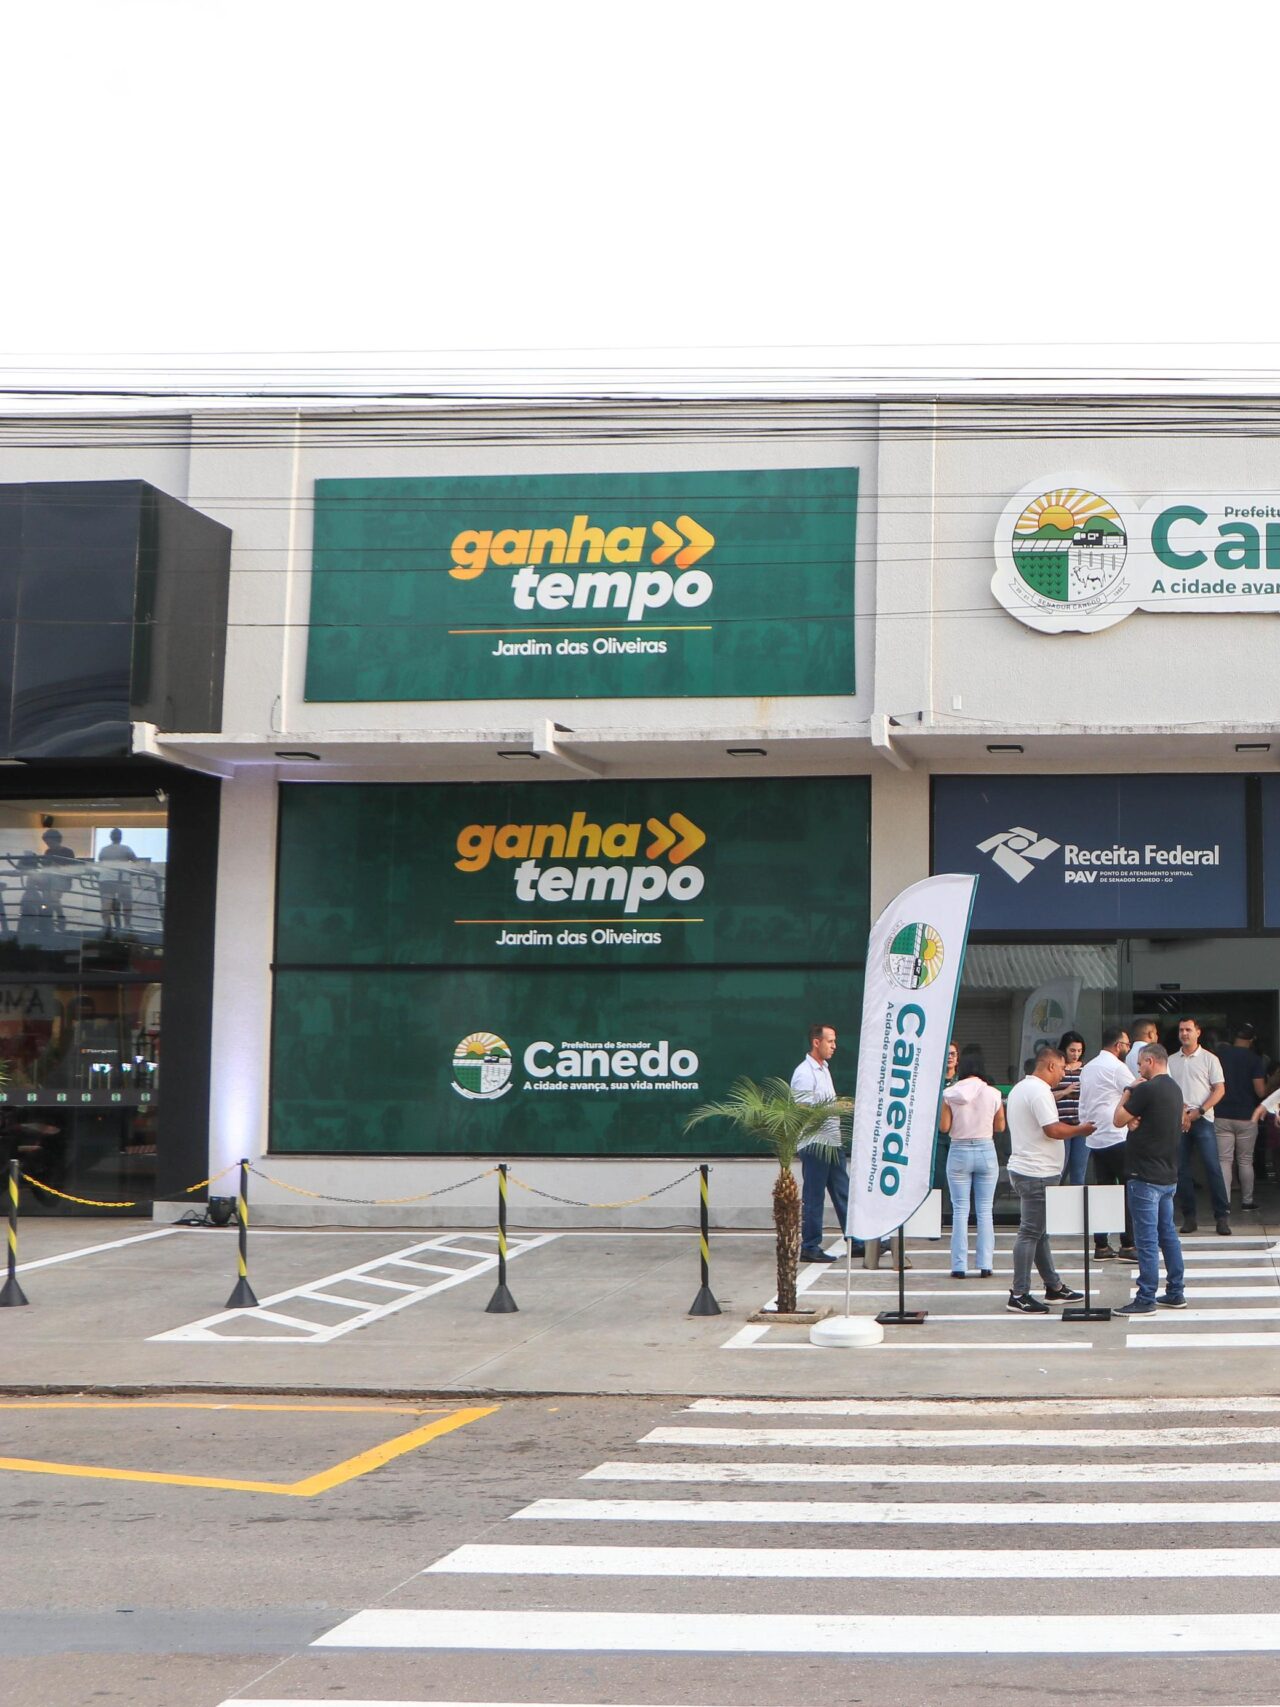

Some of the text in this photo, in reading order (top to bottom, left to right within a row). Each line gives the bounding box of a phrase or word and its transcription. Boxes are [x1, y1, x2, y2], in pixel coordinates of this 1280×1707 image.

[448, 515, 647, 581] ganha
[510, 565, 714, 621] tempo
[1151, 579, 1166, 594] A
[1170, 579, 1237, 594] cidade
[491, 637, 668, 656] Jardim das Oliveiras
[454, 811, 642, 873] ganha
[1065, 844, 1220, 866] Receita Federal
[513, 859, 706, 913] tempo
[1064, 870, 1098, 884] PAV
[496, 929, 662, 945] Jardim das Oliveiras
[887, 1001, 894, 1010] A
[561, 1041, 651, 1049] Prefeitura de Senador
[882, 1012, 893, 1051] cidade
[523, 1040, 699, 1078] Canedo
[523, 1081, 532, 1090] A
[533, 1081, 569, 1090] cidade
[570, 1081, 609, 1092] avança,
[610, 1082, 629, 1090] sua
[630, 1081, 653, 1090] vida
[654, 1081, 699, 1090] melhora
[879, 1003, 926, 1197] Canedo
[905, 1047, 922, 1147] Prefeitura de Senador
[872, 1118, 883, 1143] vida
[867, 1145, 878, 1193] melhora
